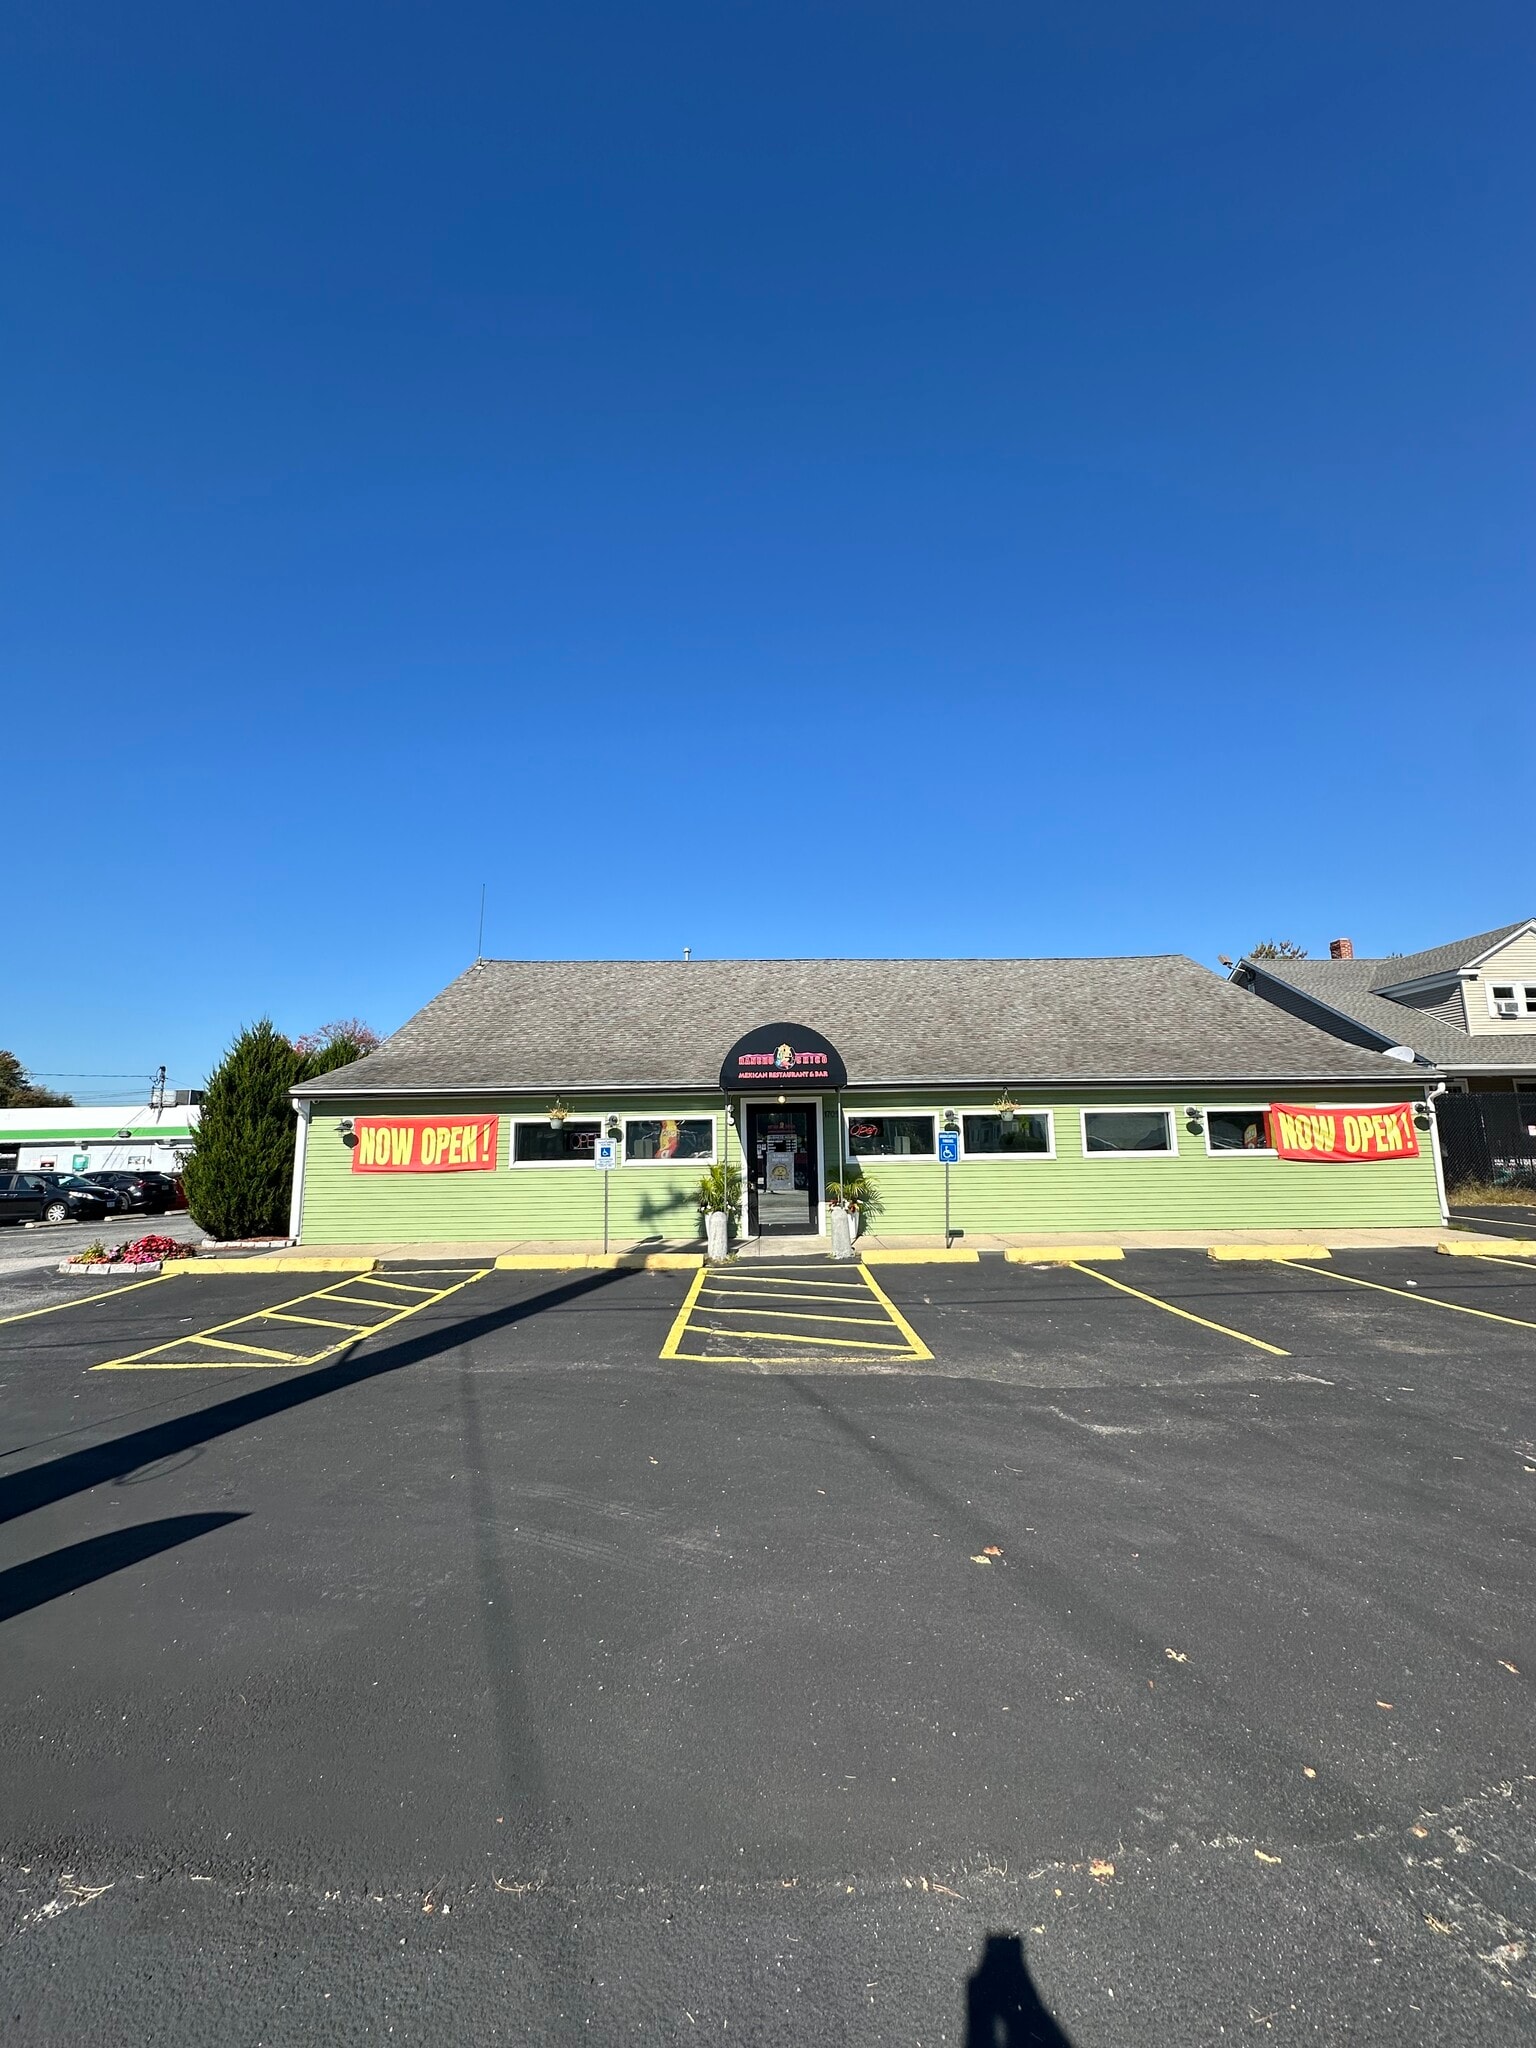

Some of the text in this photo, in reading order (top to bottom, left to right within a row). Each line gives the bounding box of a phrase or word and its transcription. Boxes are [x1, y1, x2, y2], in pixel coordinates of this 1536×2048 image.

[796, 1055, 828, 1064] CHICO
[850, 1124, 878, 1136] Open
[1277, 1112, 1414, 1153] NOW OPEN!
[359, 1124, 491, 1166] NOW OPEN!
[571, 1133, 600, 1149] OPE
